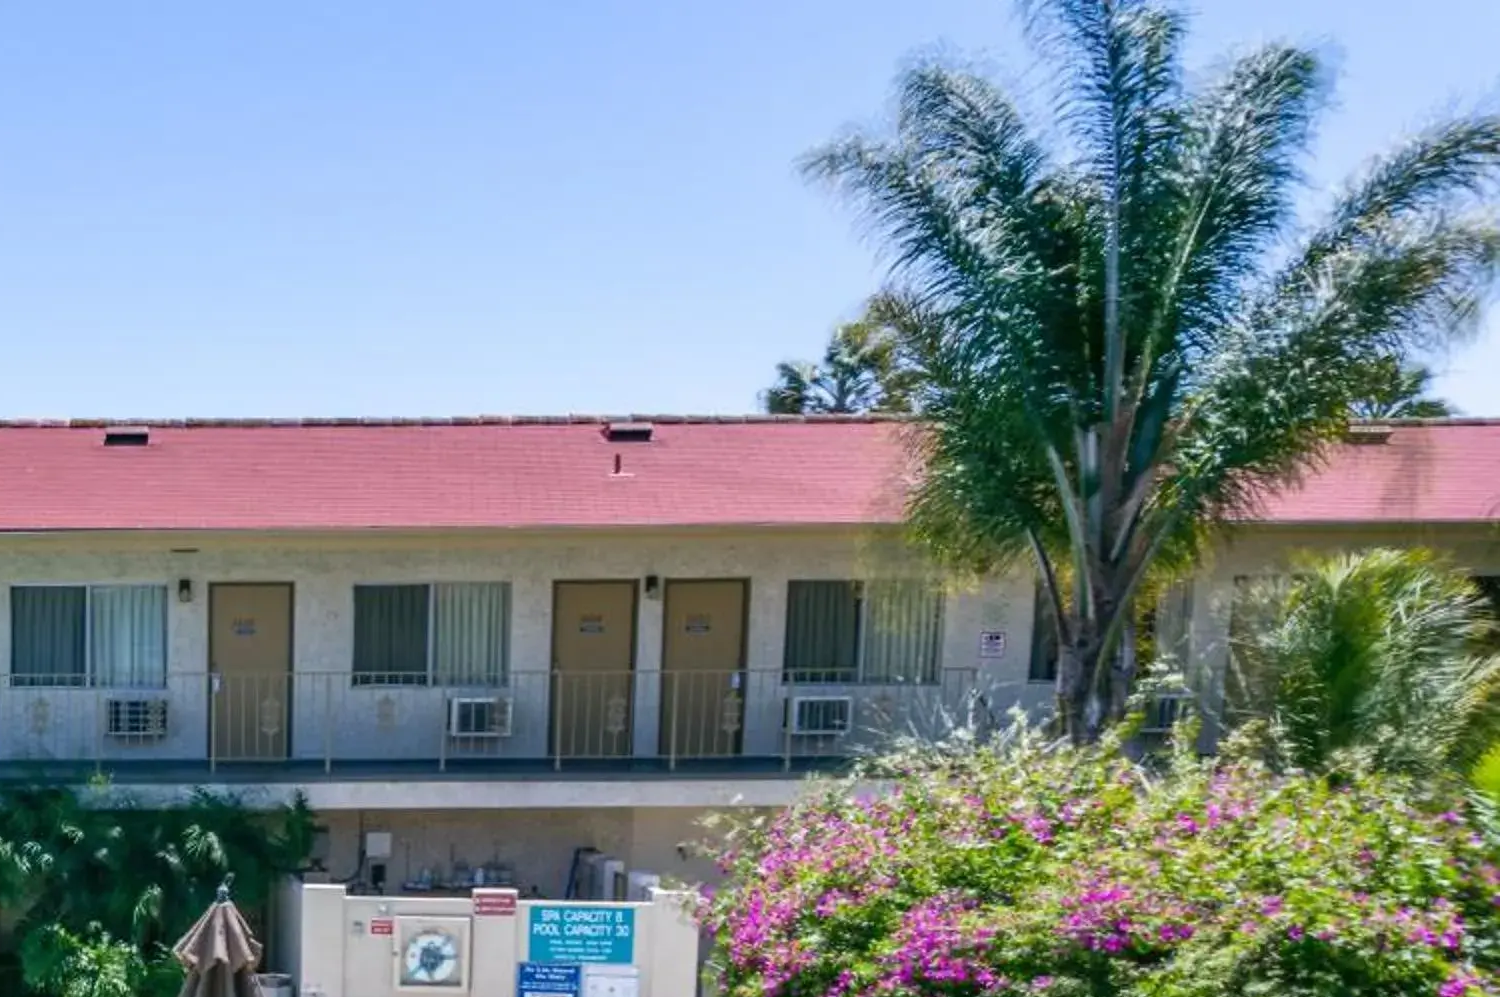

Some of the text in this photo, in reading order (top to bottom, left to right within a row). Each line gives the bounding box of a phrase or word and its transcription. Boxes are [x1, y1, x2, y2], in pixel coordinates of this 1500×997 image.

[541, 910, 560, 921] SPA
[563, 910, 613, 922] CAPACITY
[533, 923, 560, 936] POOL
[563, 924, 613, 936] CAPACITY
